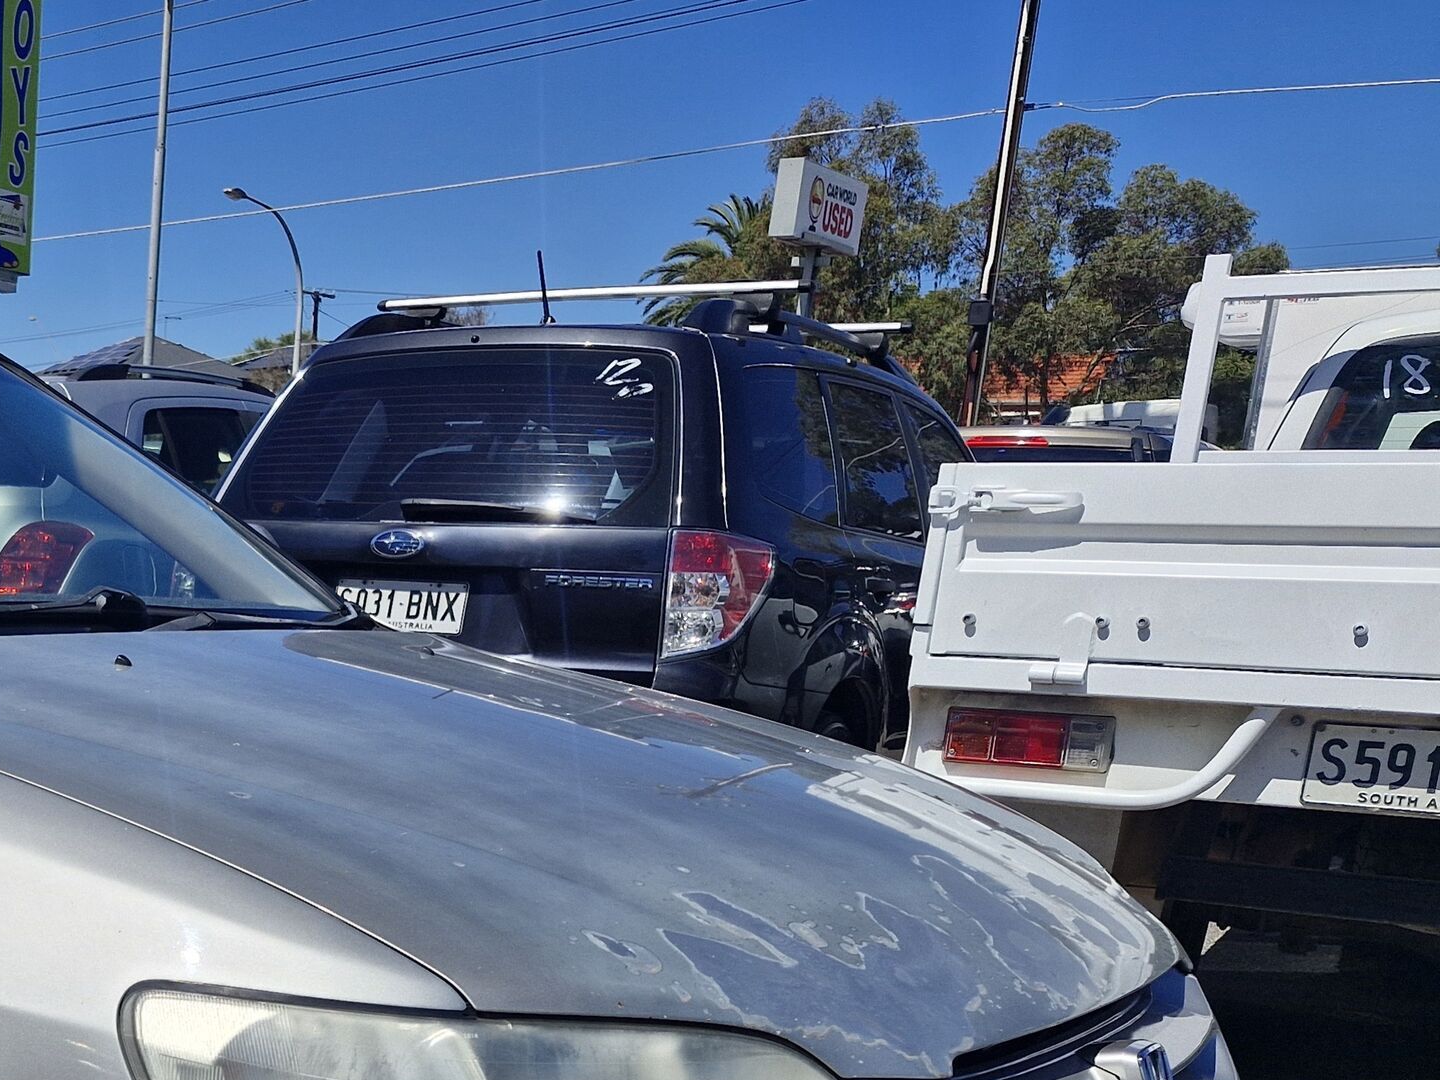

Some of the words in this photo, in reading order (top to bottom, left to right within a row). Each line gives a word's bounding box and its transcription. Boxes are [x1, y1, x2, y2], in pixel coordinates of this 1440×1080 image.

[826, 183, 839, 200] CAR
[838, 186, 858, 207] WORLD
[822, 200, 854, 239] USED
[1382, 353, 1432, 399] 18
[545, 574, 653, 589] FORESTER
[388, 620, 433, 630] USTRALIA
[1357, 792, 1418, 808] SOUTH
